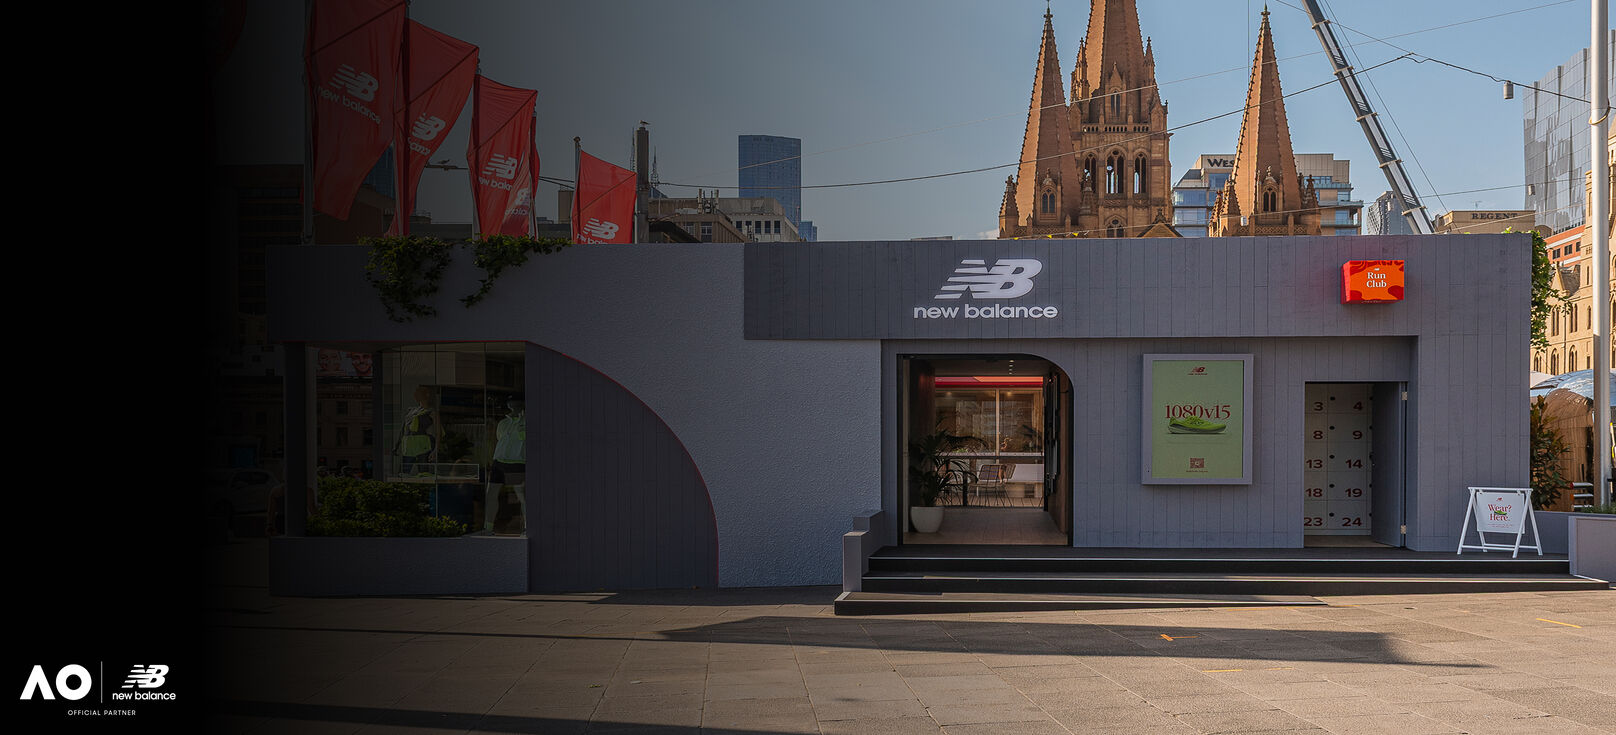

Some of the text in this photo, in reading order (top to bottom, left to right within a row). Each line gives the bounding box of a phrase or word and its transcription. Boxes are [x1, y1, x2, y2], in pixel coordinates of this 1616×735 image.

[342, 95, 381, 125] balance
[1472, 212, 1518, 220] REGENT
[934, 258, 1043, 299] NB
[1366, 280, 1387, 288] Club
[914, 303, 1058, 319] new balance
[1314, 401, 1324, 411] 3
[1353, 401, 1363, 411] 4
[1165, 404, 1231, 420] 1080v15
[1313, 430, 1323, 440] 8
[1352, 430, 1363, 440] 9
[1306, 459, 1323, 469] 13
[1345, 459, 1363, 469] 14
[1305, 488, 1323, 498] 18
[1345, 488, 1363, 498] 19
[1488, 503, 1512, 512] Wear?
[1304, 517, 1323, 527] 23
[1342, 517, 1362, 527] 24
